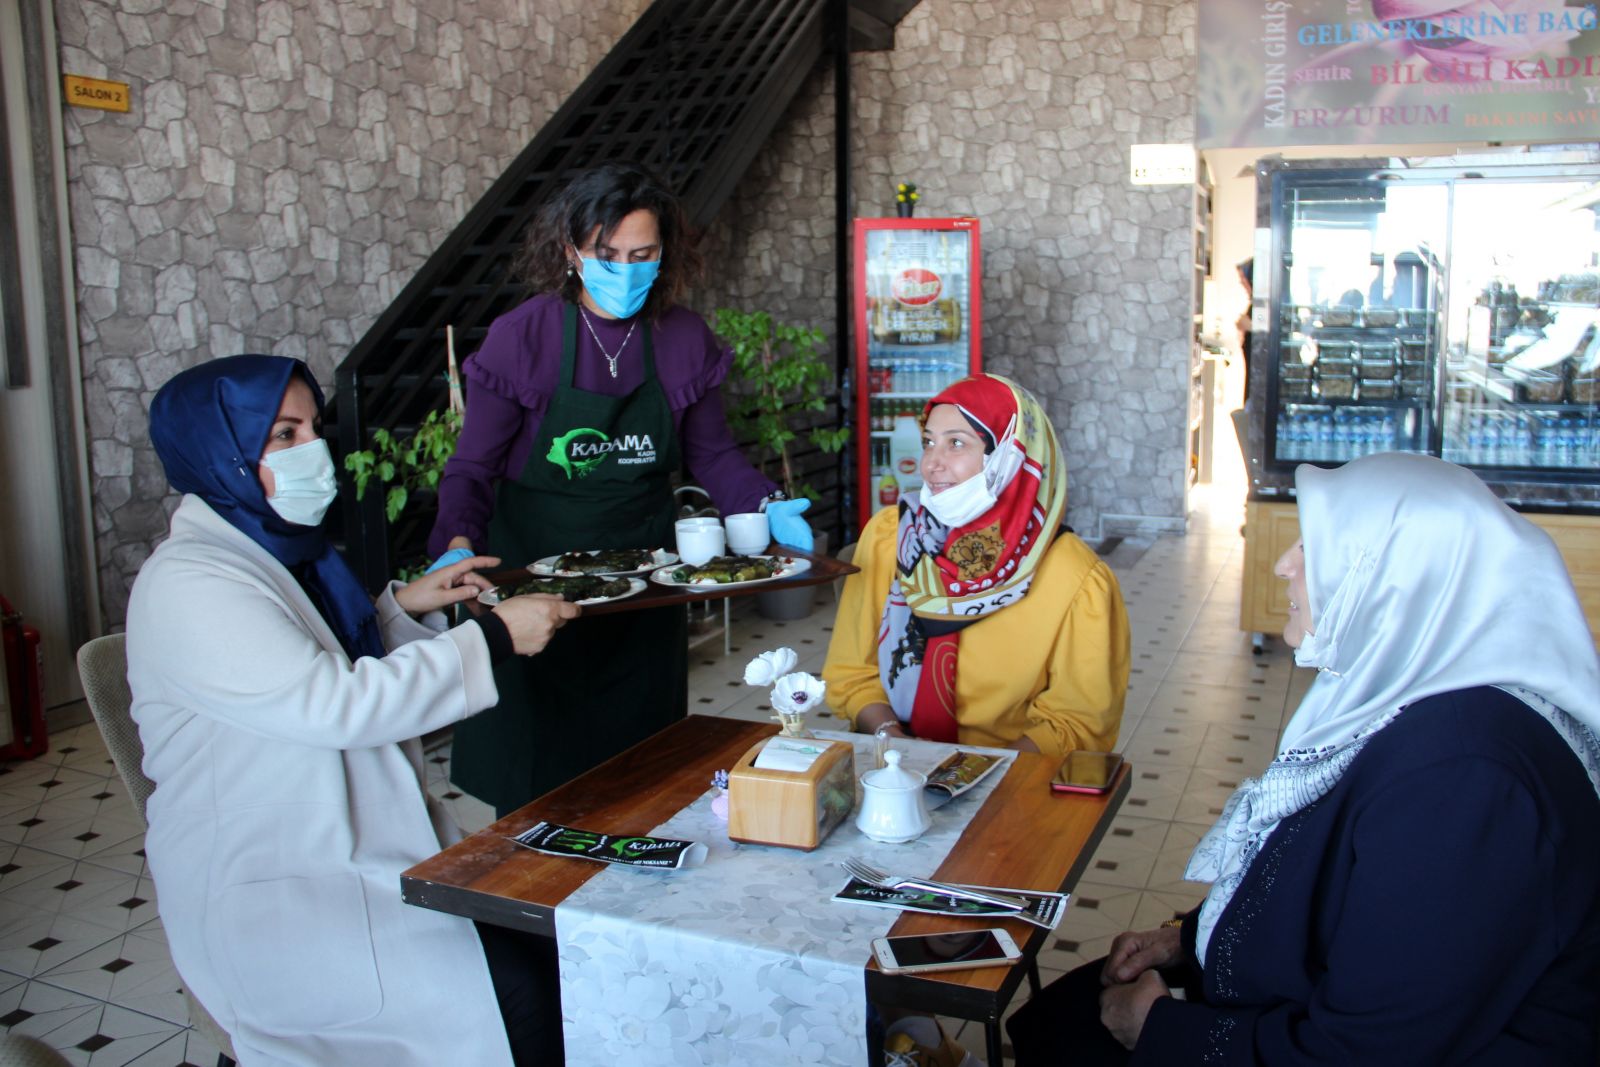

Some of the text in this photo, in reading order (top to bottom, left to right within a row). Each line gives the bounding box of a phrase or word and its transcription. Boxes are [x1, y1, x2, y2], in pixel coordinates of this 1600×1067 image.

[1297, 3, 1598, 46] GELENEKLERİNE BAĞ
[1370, 55, 1600, 86] BİLGİLİ KADI
[74, 86, 122, 102] SALON 2
[1264, 63, 1286, 128] KADIN
[1291, 104, 1450, 129] ERZURUM
[571, 434, 655, 457] KADAMA
[627, 841, 681, 851] KADAMA
